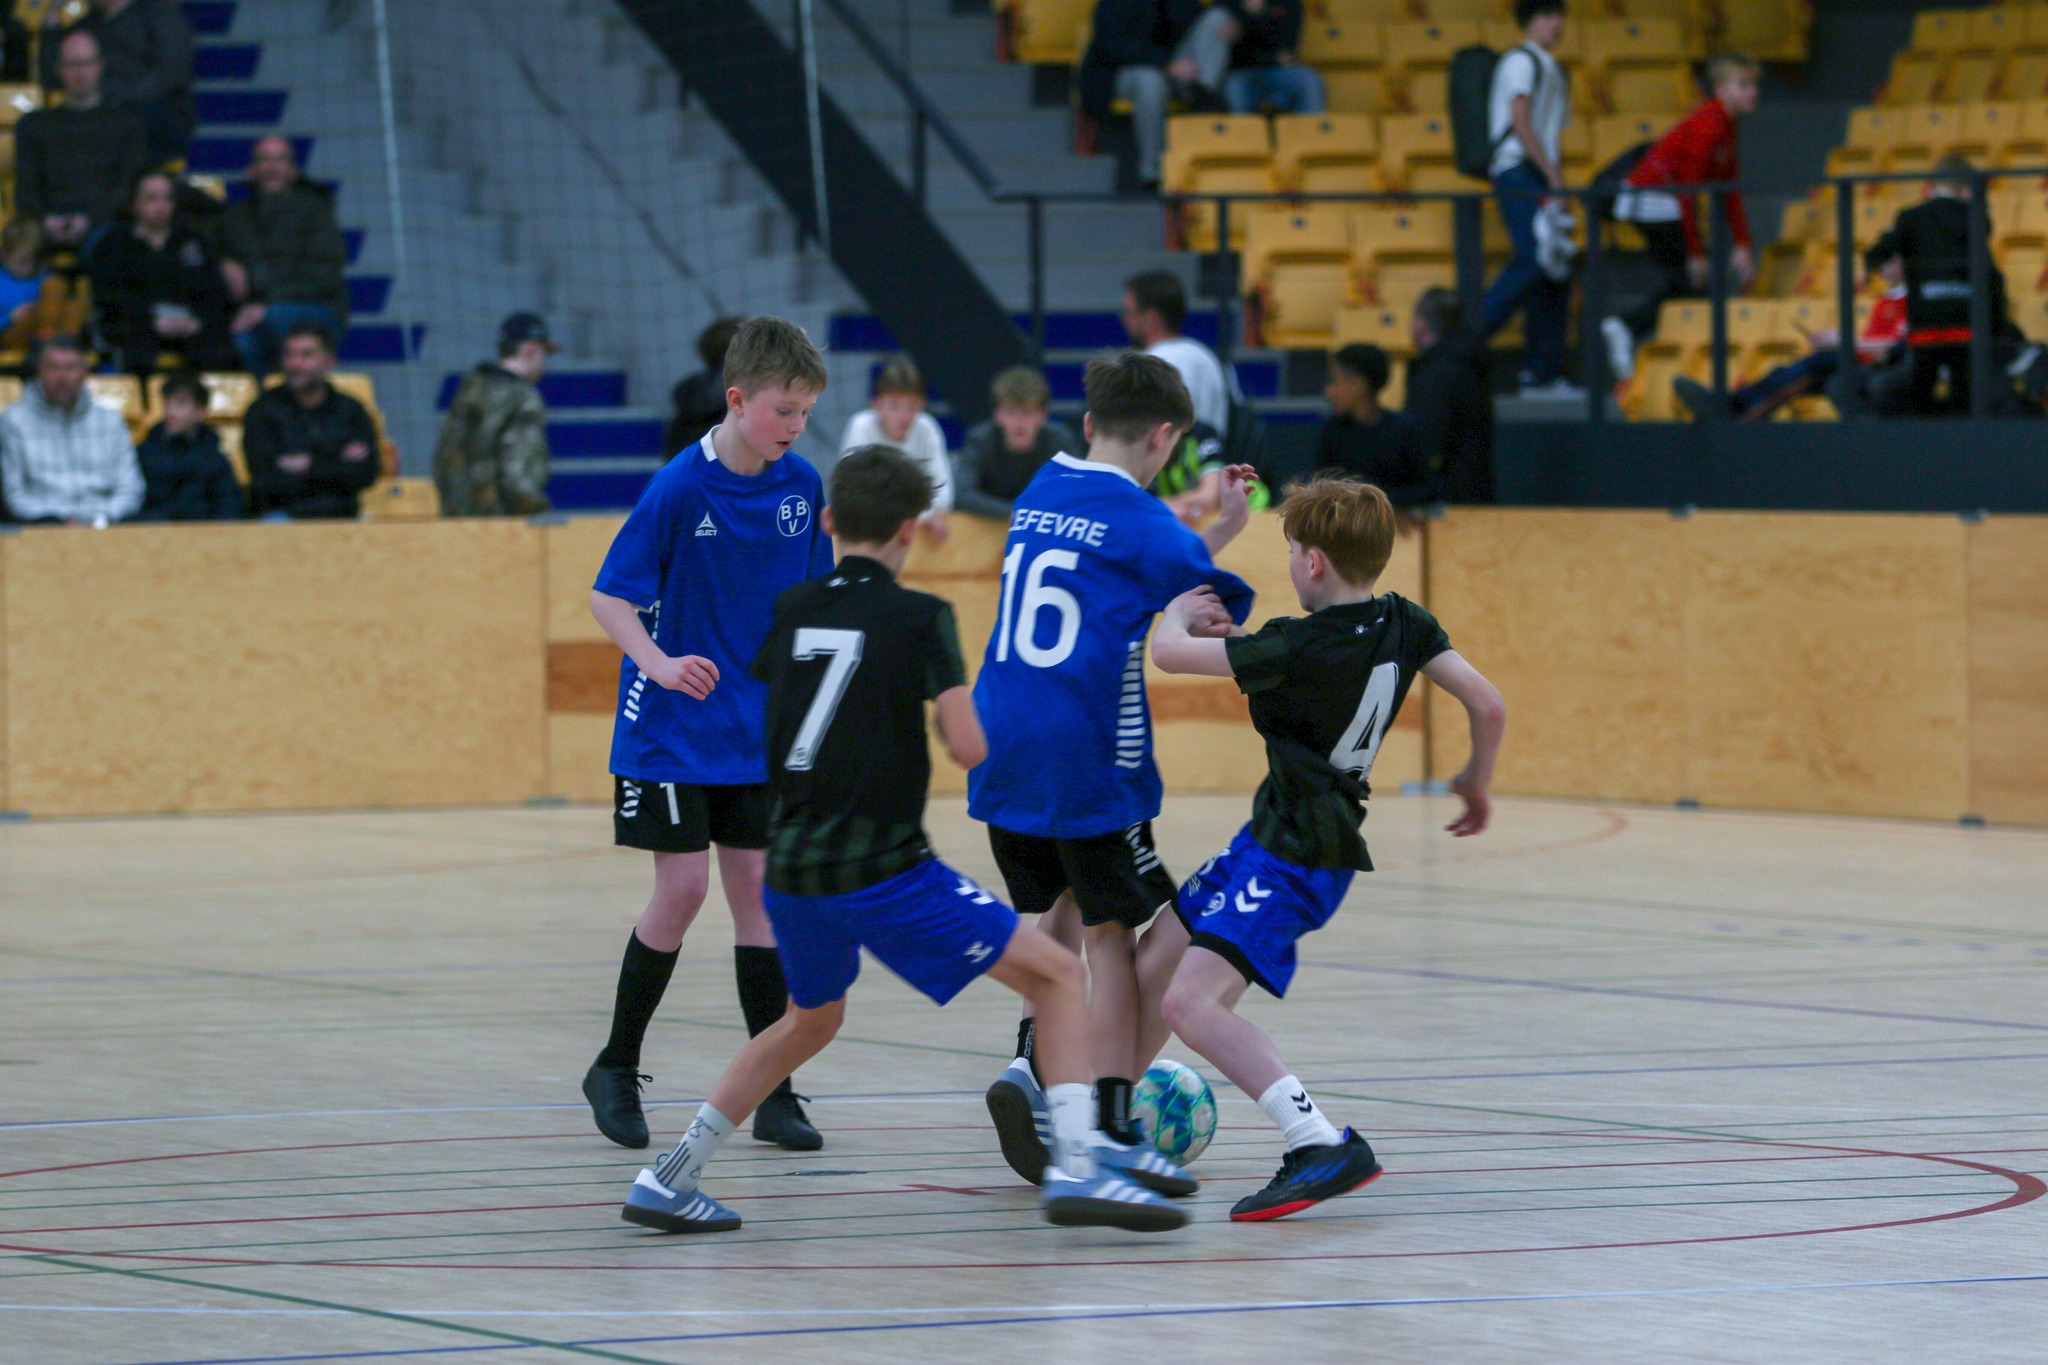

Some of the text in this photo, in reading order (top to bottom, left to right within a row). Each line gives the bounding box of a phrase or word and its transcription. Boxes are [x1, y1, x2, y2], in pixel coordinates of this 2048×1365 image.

[694, 529, 718, 537] SELECT
[1008, 508, 1110, 548] EFEVRE
[995, 542, 1082, 668] 16
[784, 627, 866, 771] 7
[1328, 661, 1400, 782] 4
